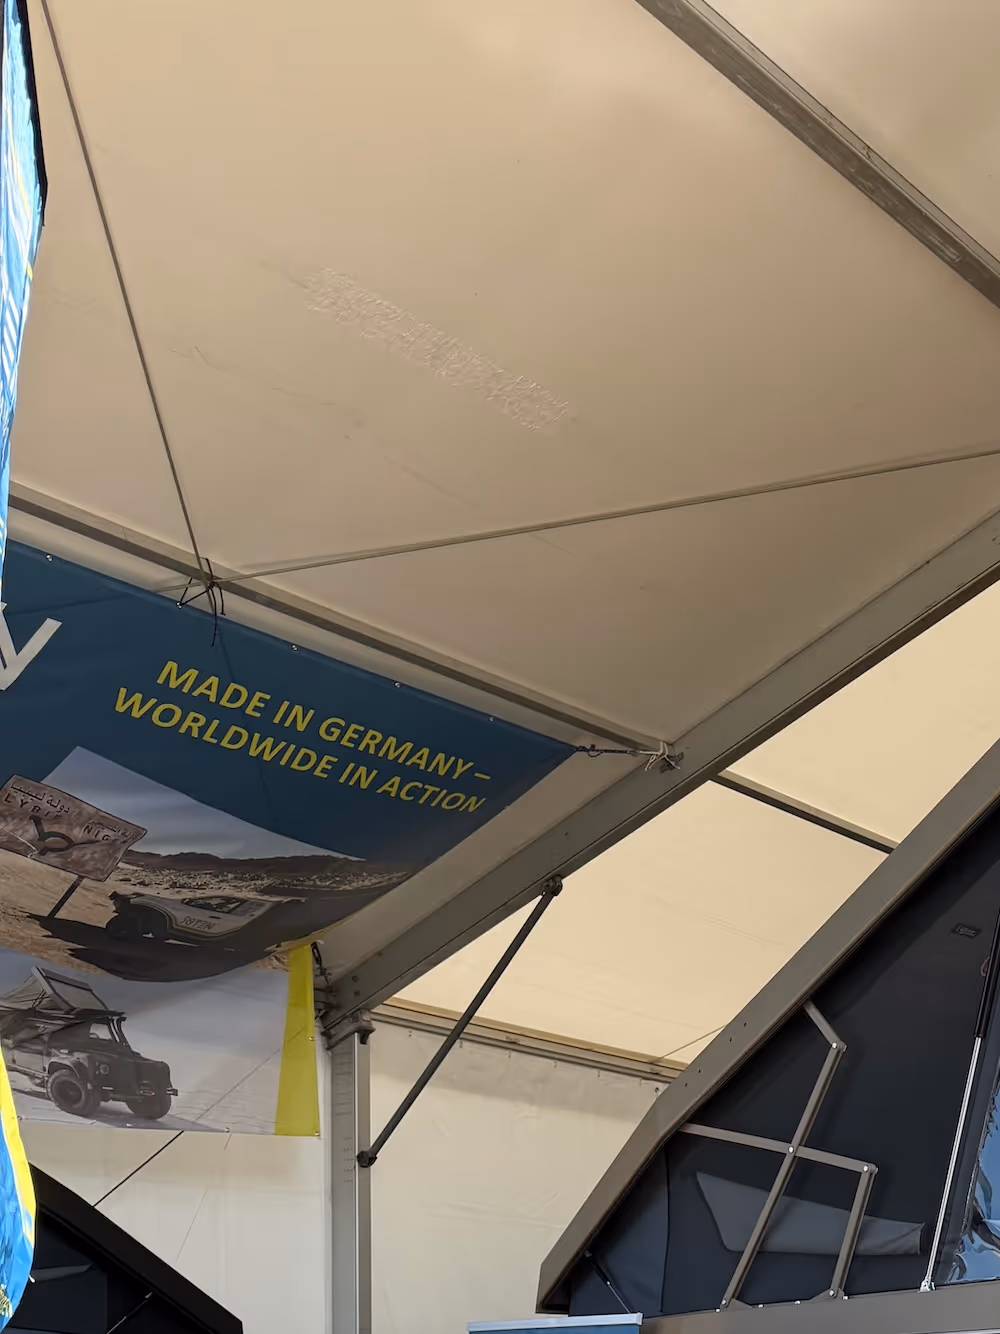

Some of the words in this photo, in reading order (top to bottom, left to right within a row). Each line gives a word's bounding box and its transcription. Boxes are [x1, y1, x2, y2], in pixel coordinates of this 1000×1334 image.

[114, 687, 338, 779] WORLDWIDE
[339, 763, 378, 790] IN
[377, 776, 487, 813] ACTION
[157, 661, 271, 718] MADE
[273, 700, 315, 732] IN
[319, 717, 474, 780] GERMANY
